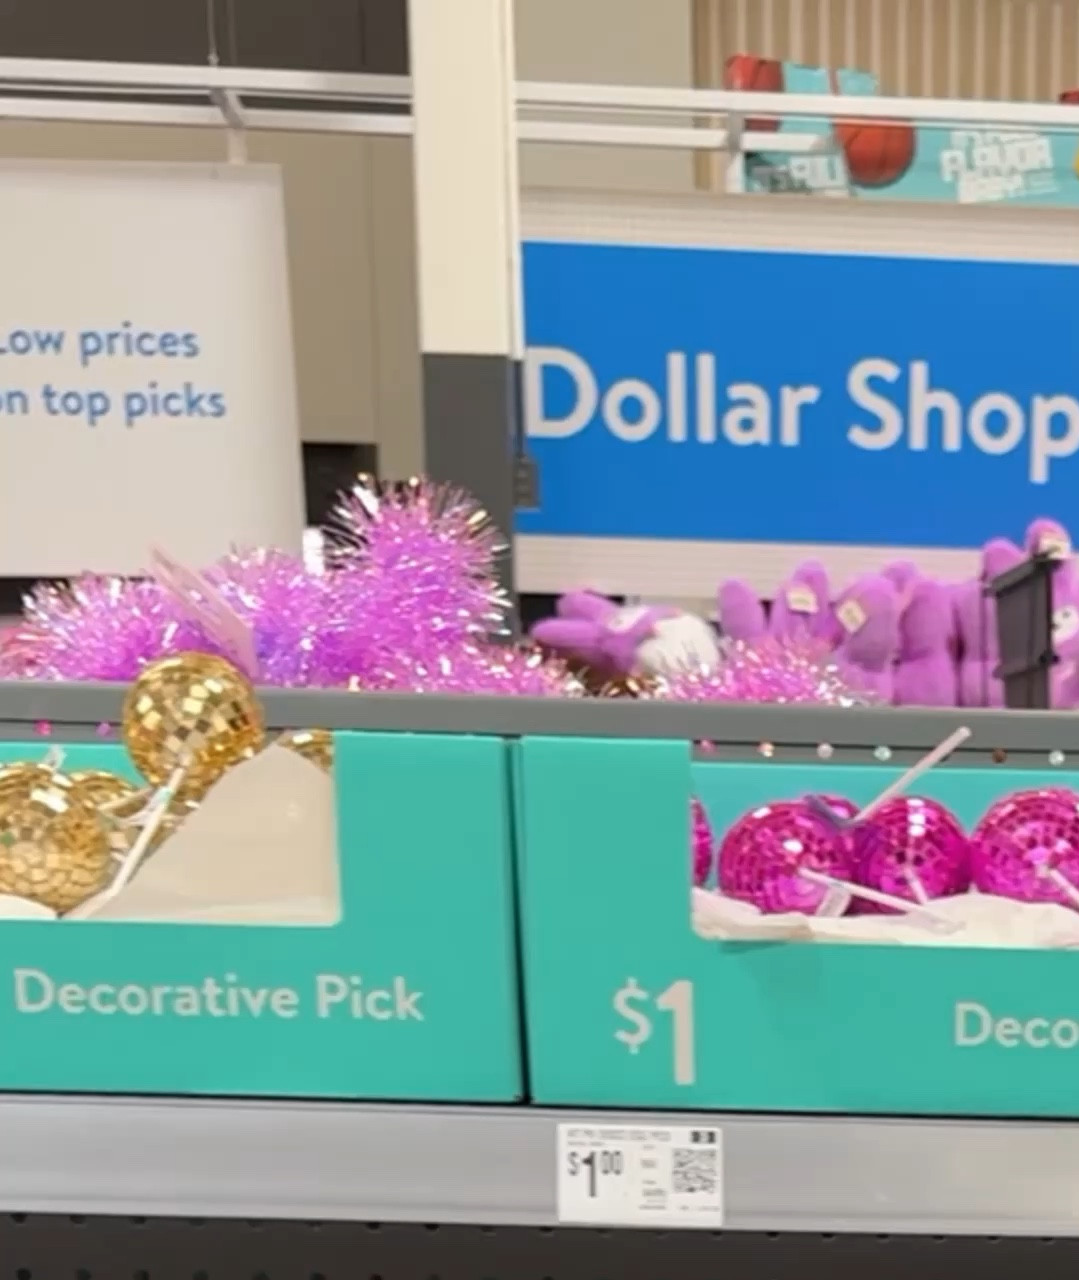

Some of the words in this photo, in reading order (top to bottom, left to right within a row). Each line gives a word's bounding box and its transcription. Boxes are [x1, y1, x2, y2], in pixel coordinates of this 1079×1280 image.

[0, 329, 65, 355] ow
[79, 320, 200, 368] prices
[0, 390, 29, 415] n
[42, 383, 111, 427] top
[124, 380, 227, 428] picks
[524, 346, 820, 446] Dollar
[12, 967, 299, 1019] Decorative
[315, 974, 425, 1022] Pick
[611, 975, 697, 1086] $1
